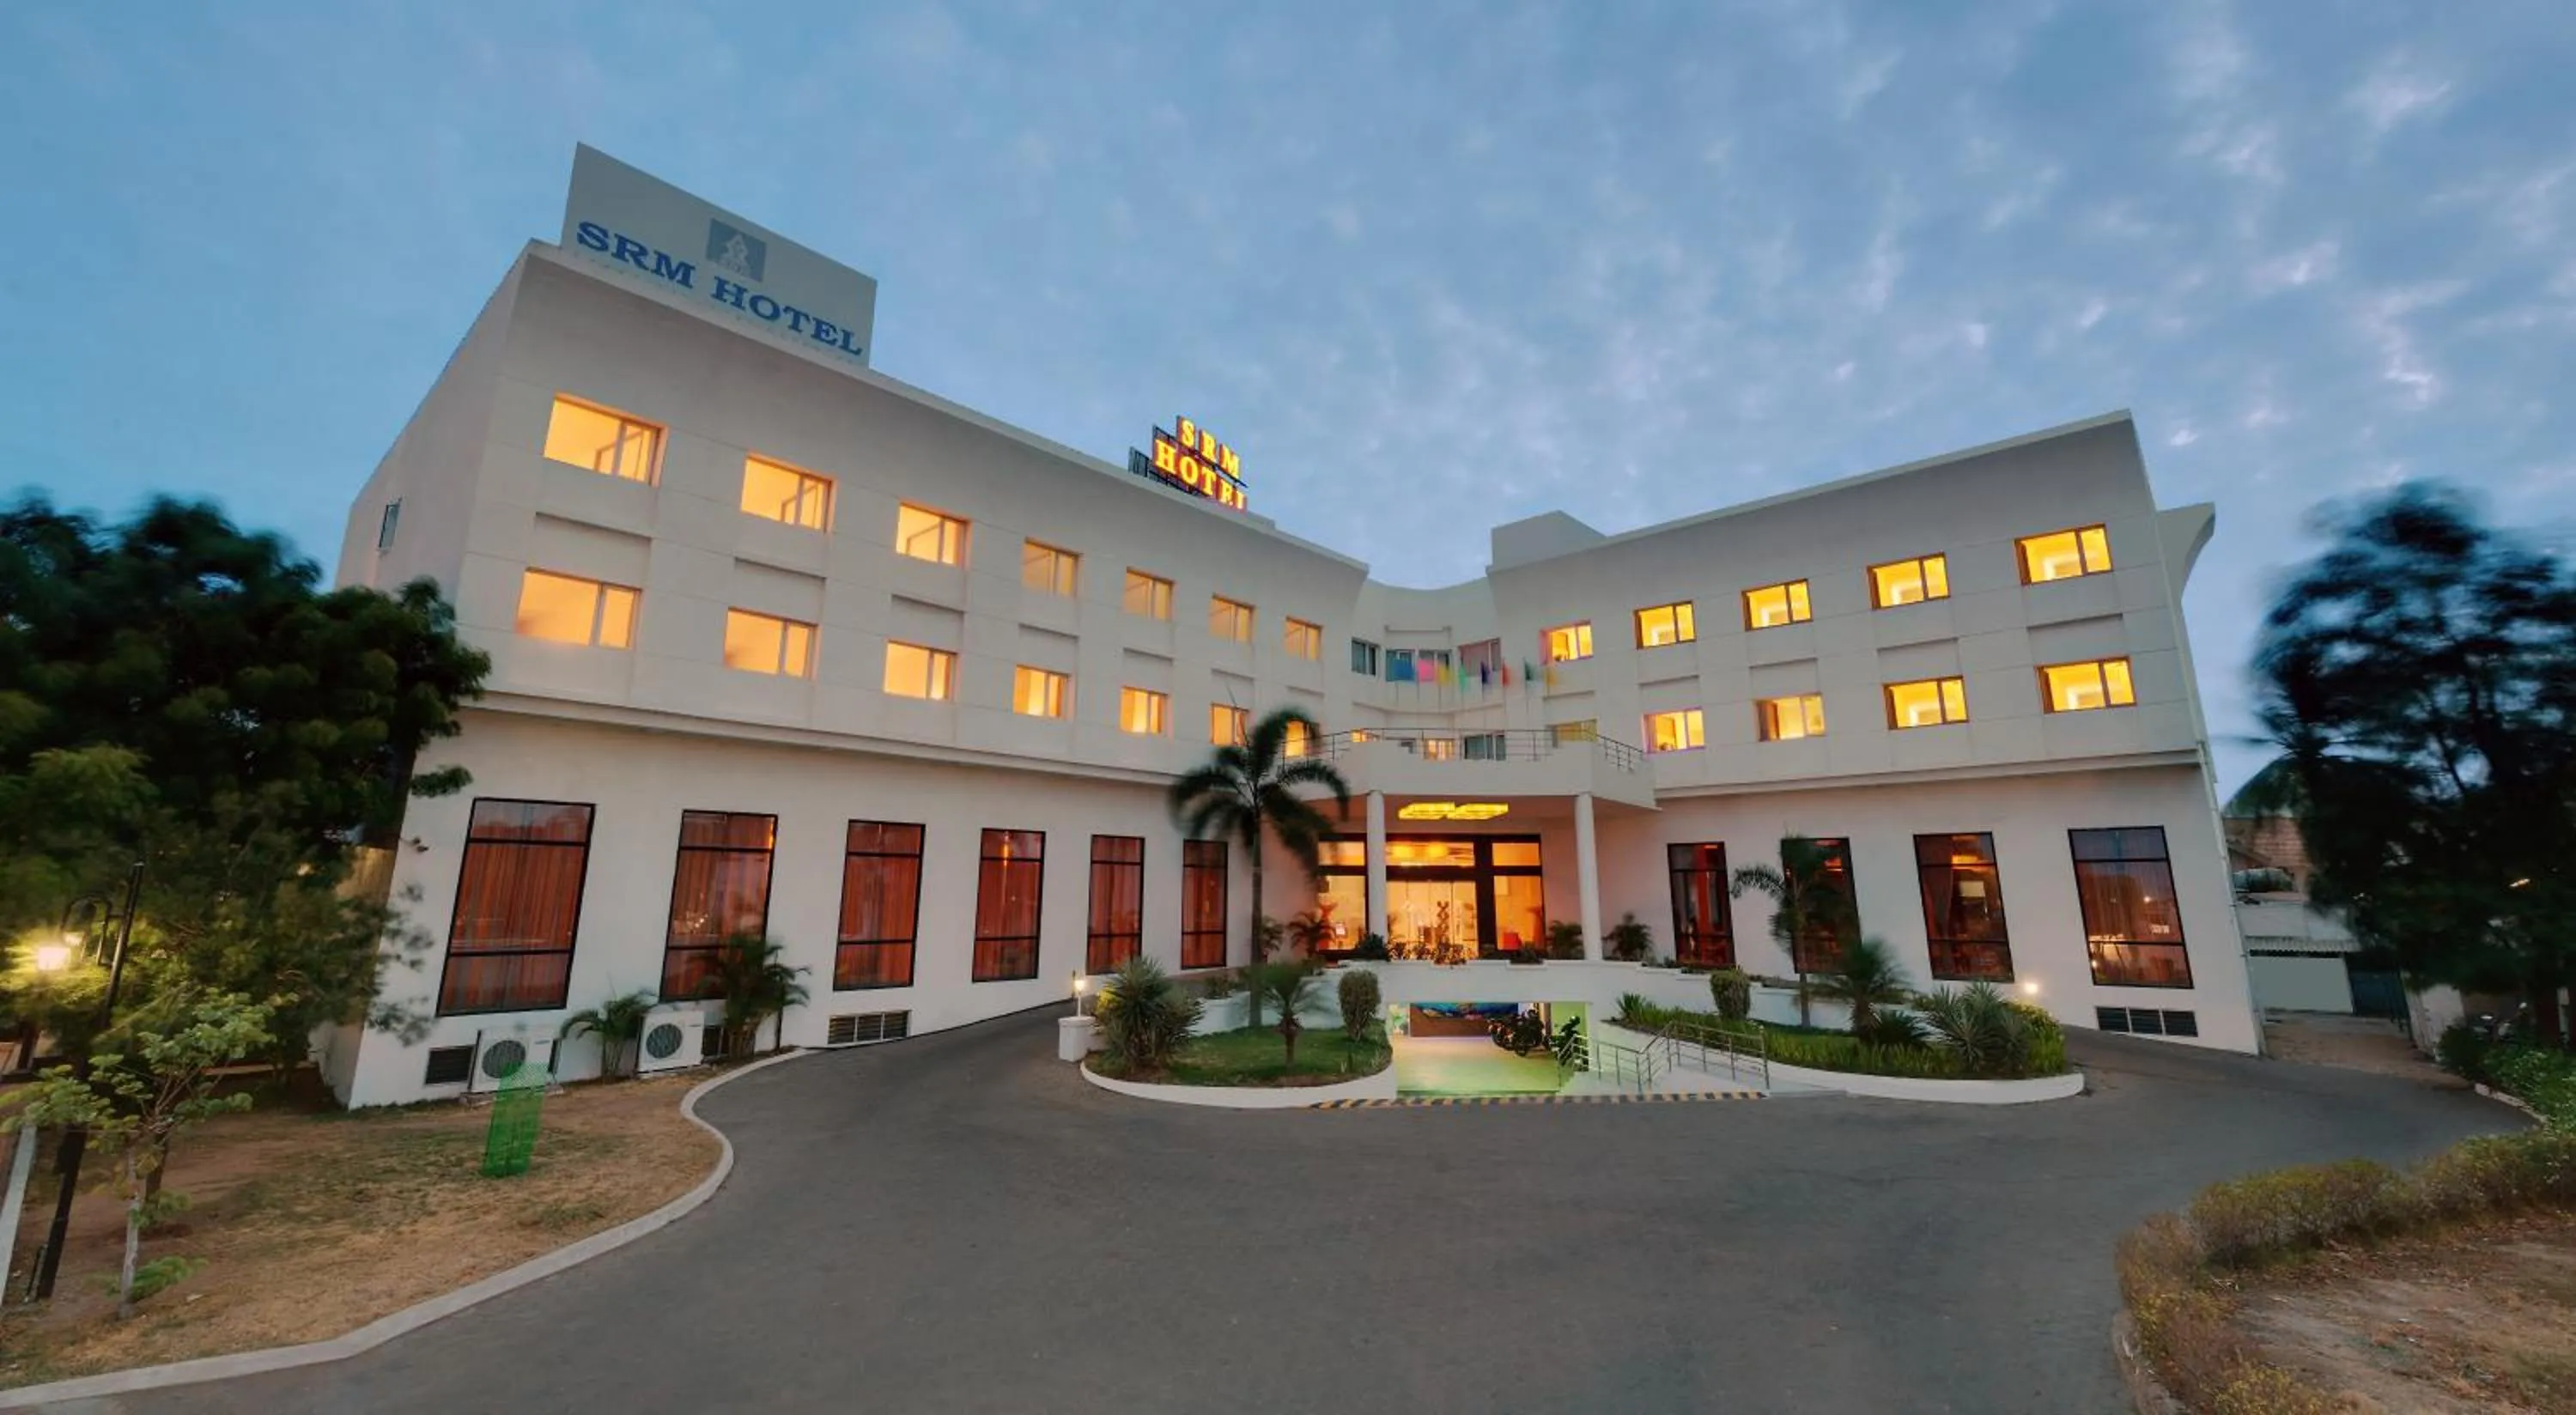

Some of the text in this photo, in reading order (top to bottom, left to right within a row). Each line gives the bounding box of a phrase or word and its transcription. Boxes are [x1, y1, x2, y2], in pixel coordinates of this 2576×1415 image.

[576, 221, 863, 355] SRM HOTEL
[1180, 418, 1241, 479] SRM
